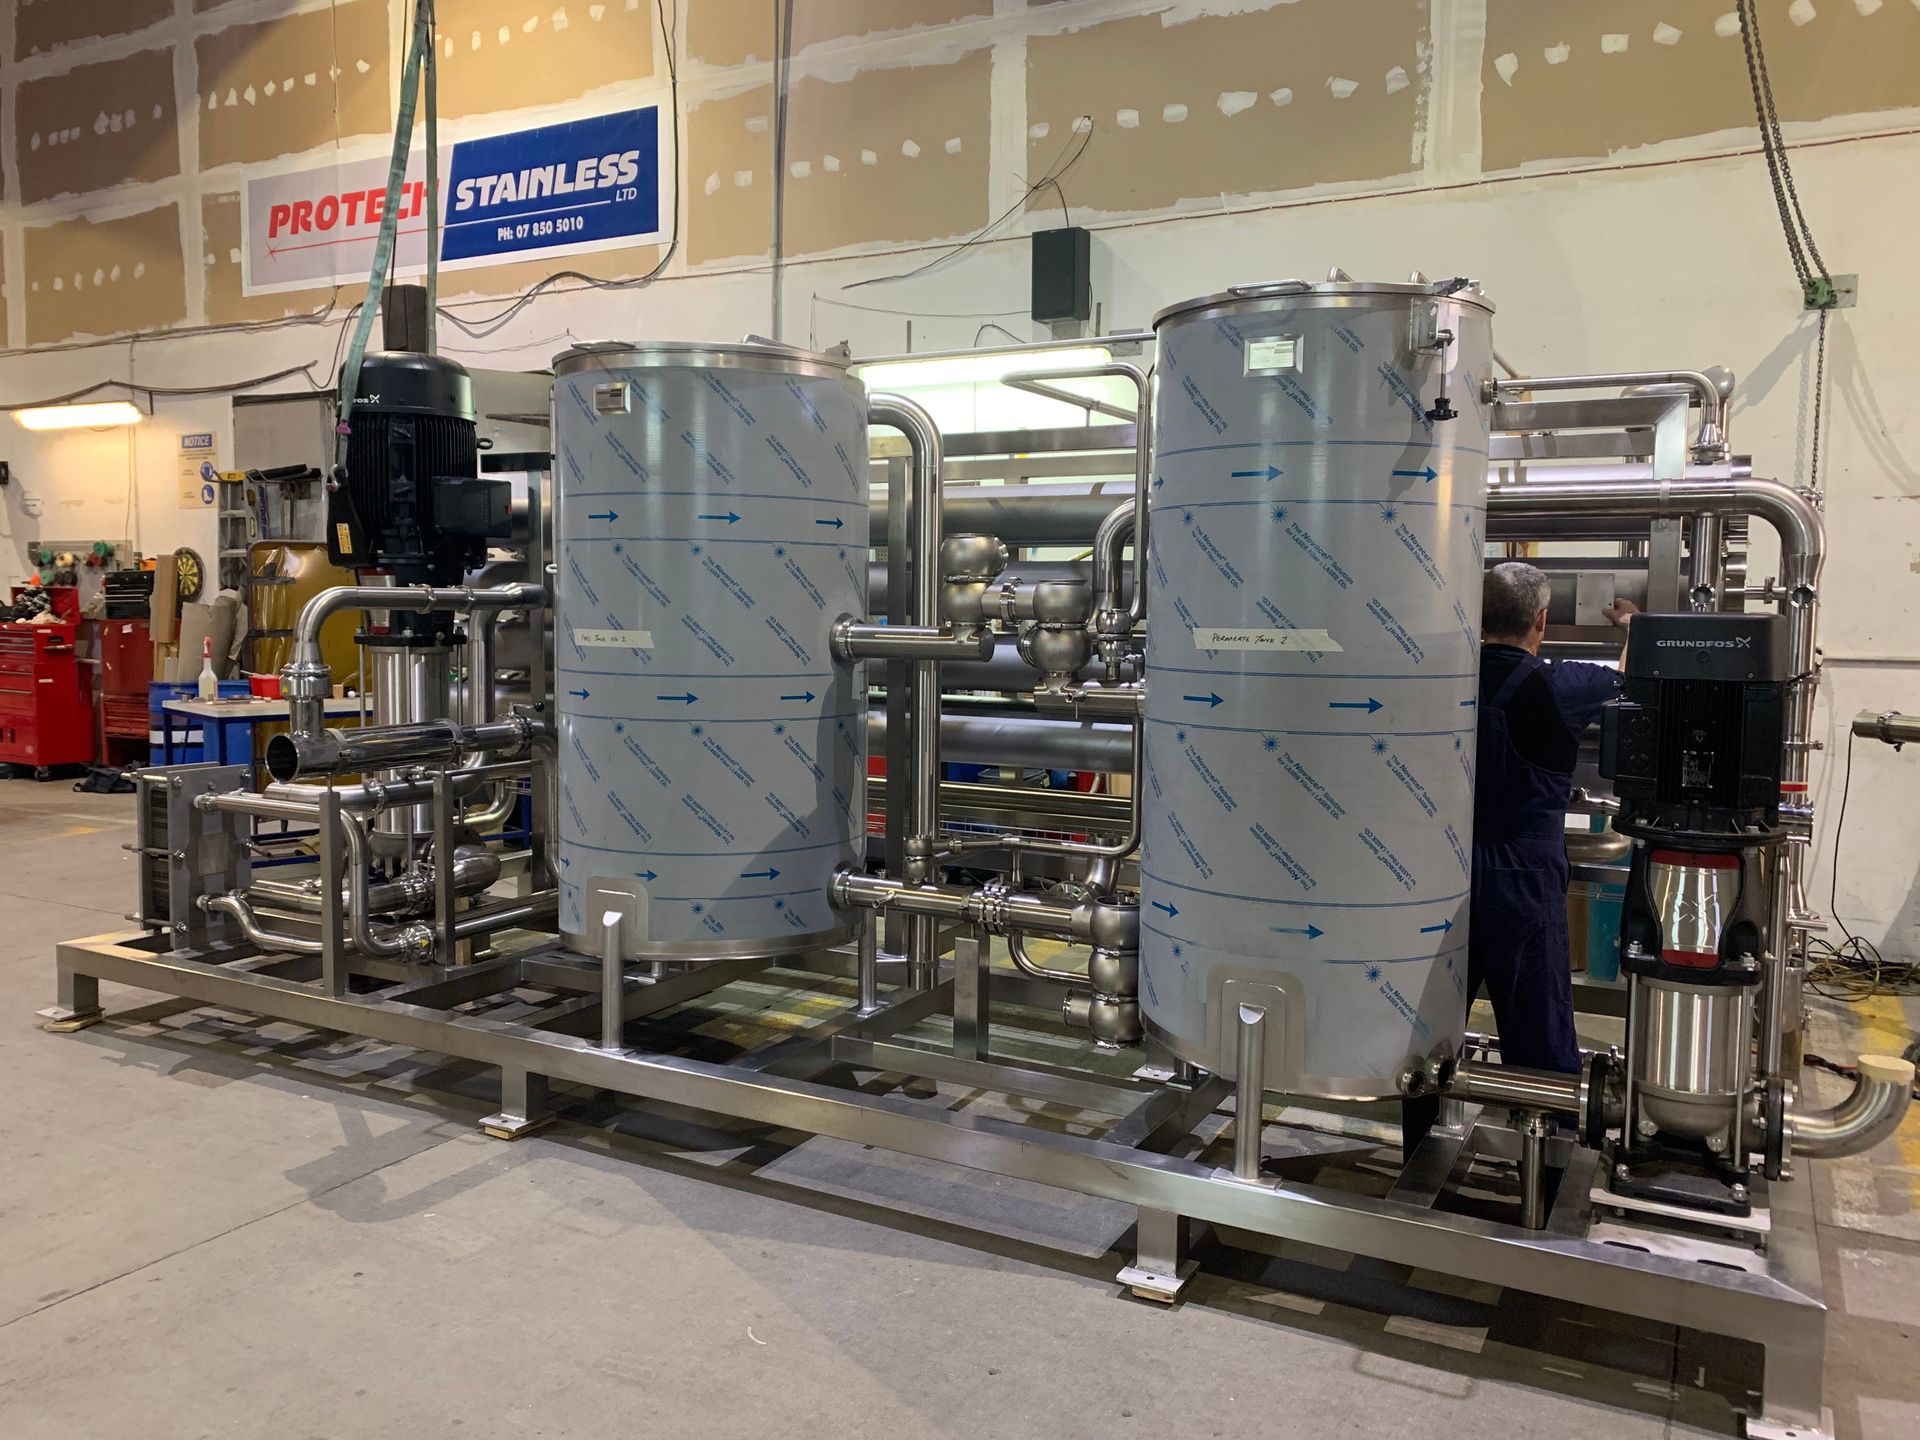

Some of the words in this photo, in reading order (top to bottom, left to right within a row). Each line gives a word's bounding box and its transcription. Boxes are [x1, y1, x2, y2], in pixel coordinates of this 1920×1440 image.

[455, 150, 640, 211] STAINLESS
[615, 187, 638, 202] LTD
[497, 225, 513, 241] PH:
[516, 223, 529, 239] 07
[532, 220, 553, 236] 850
[556, 215, 584, 233] 5010
[183, 436, 211, 447] NOTICE
[1280, 636, 1288, 645] 2
[1656, 640, 1735, 648] GRUNDFOS
